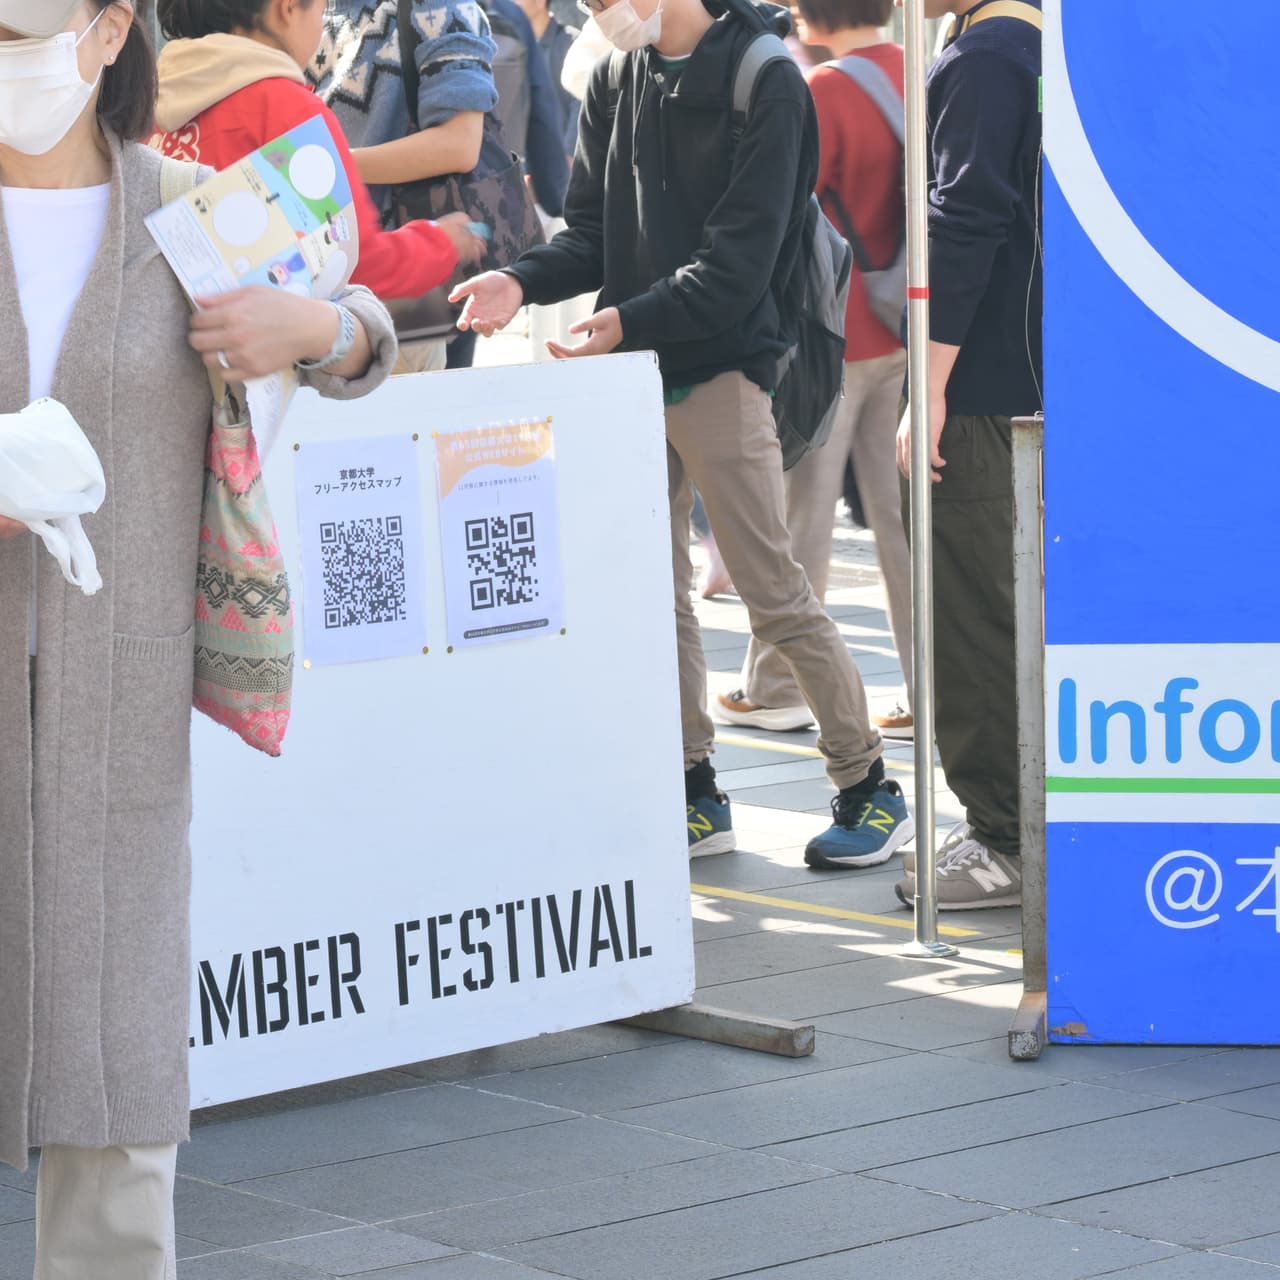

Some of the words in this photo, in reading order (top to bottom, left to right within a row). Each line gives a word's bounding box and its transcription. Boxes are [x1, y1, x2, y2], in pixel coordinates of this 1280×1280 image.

[339, 467, 375, 480] 京都大学
[314, 476, 402, 495] フリーアクセスマップ
[189, 931, 366, 1048] MBER
[394, 879, 653, 1006] FESTIVAL
